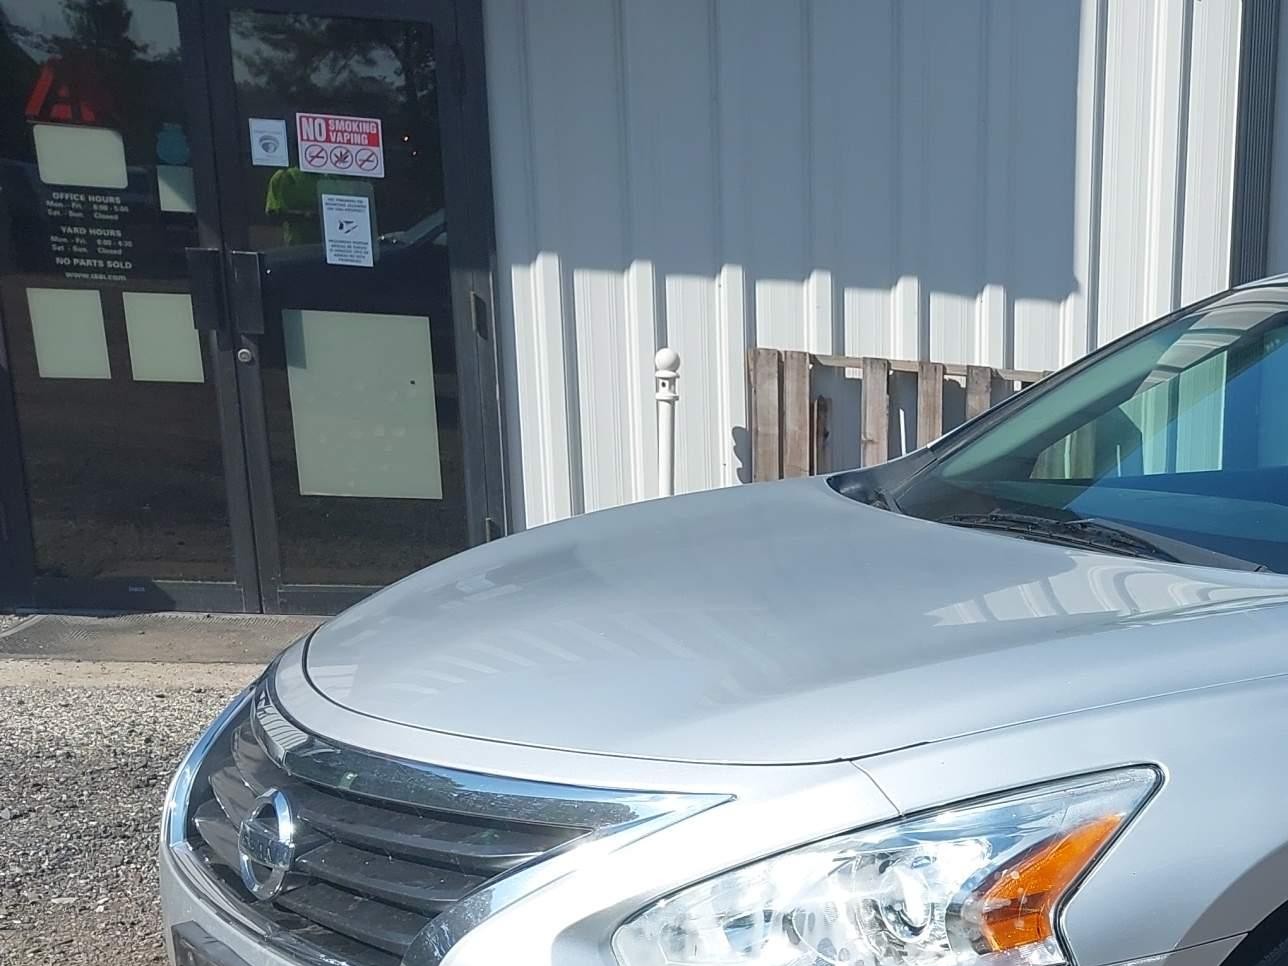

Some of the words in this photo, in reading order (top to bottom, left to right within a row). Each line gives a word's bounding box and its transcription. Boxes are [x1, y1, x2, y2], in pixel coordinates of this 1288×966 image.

[300, 117, 327, 141] NO
[328, 119, 377, 133] SMOKING
[329, 131, 369, 145] VAPING
[52, 192, 86, 201] OFFICE
[88, 195, 121, 204] HOURS
[60, 226, 87, 235] YARD
[89, 228, 122, 237] HOURS
[55, 257, 71, 265] NO
[73, 258, 104, 267] PARTS
[106, 260, 132, 269] SOLD
